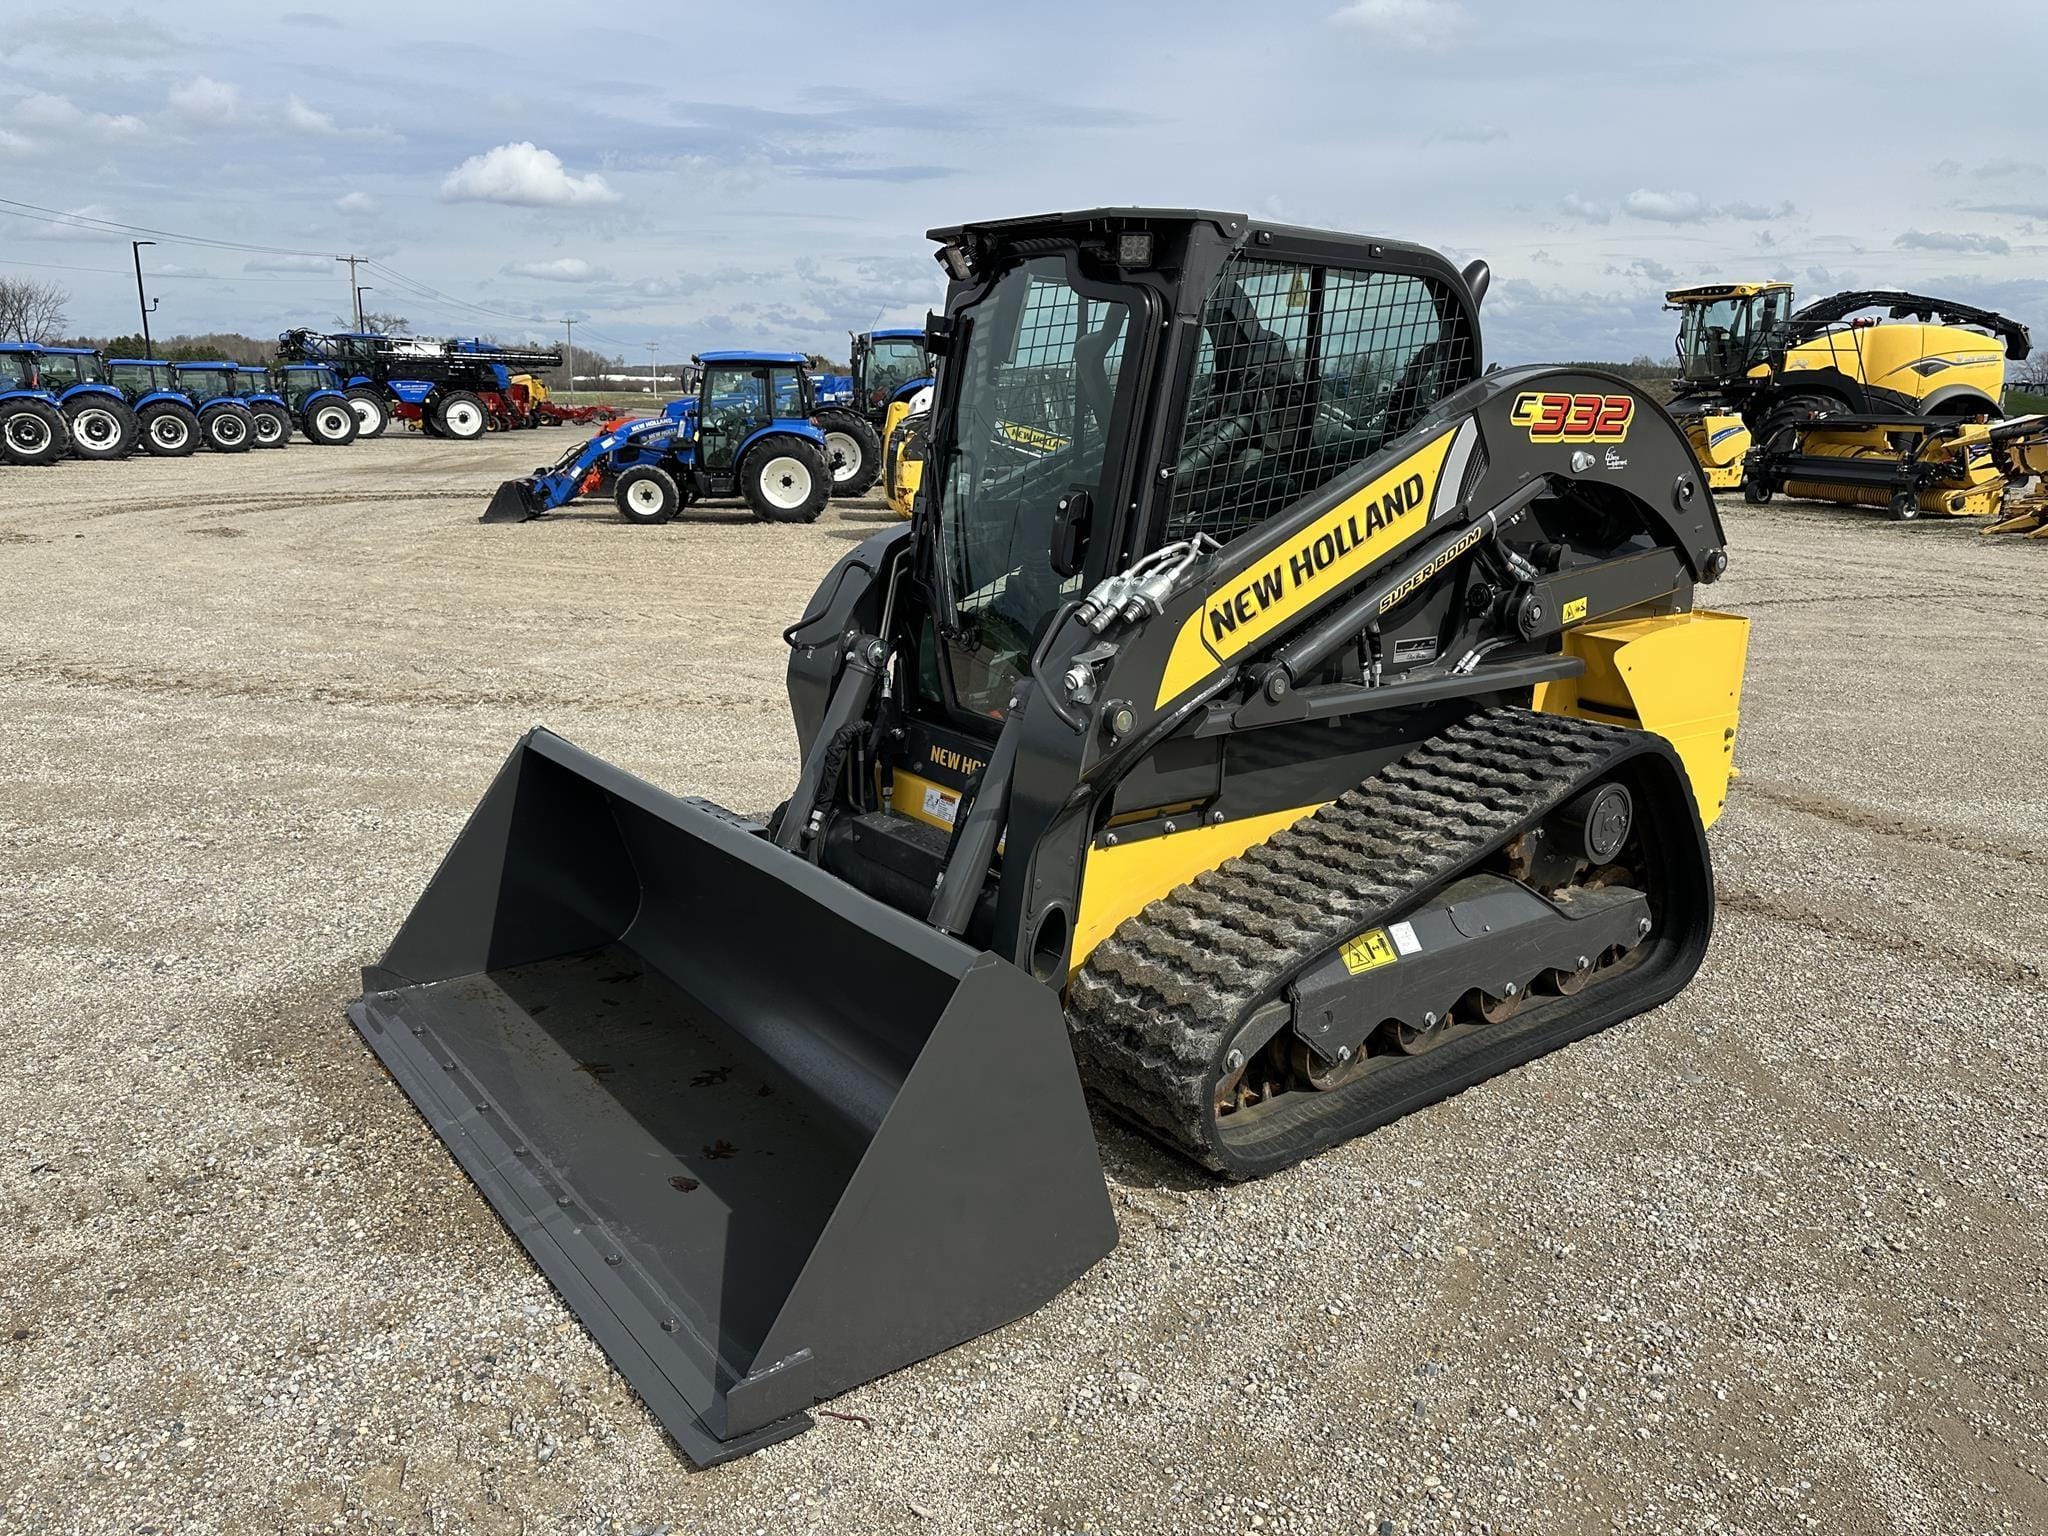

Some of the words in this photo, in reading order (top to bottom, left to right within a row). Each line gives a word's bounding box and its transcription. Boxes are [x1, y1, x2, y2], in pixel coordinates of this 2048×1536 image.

[631, 424, 645, 432] NEW
[646, 418, 673, 428] HOLLAND
[1511, 393, 1634, 442] C332
[1209, 564, 1284, 642] NEW
[1289, 472, 1425, 589] HOLLAND
[1379, 563, 1434, 614] SUPER
[1435, 527, 1482, 573] BOOM
[930, 745, 961, 770] NEW
[961, 756, 987, 775] HO
